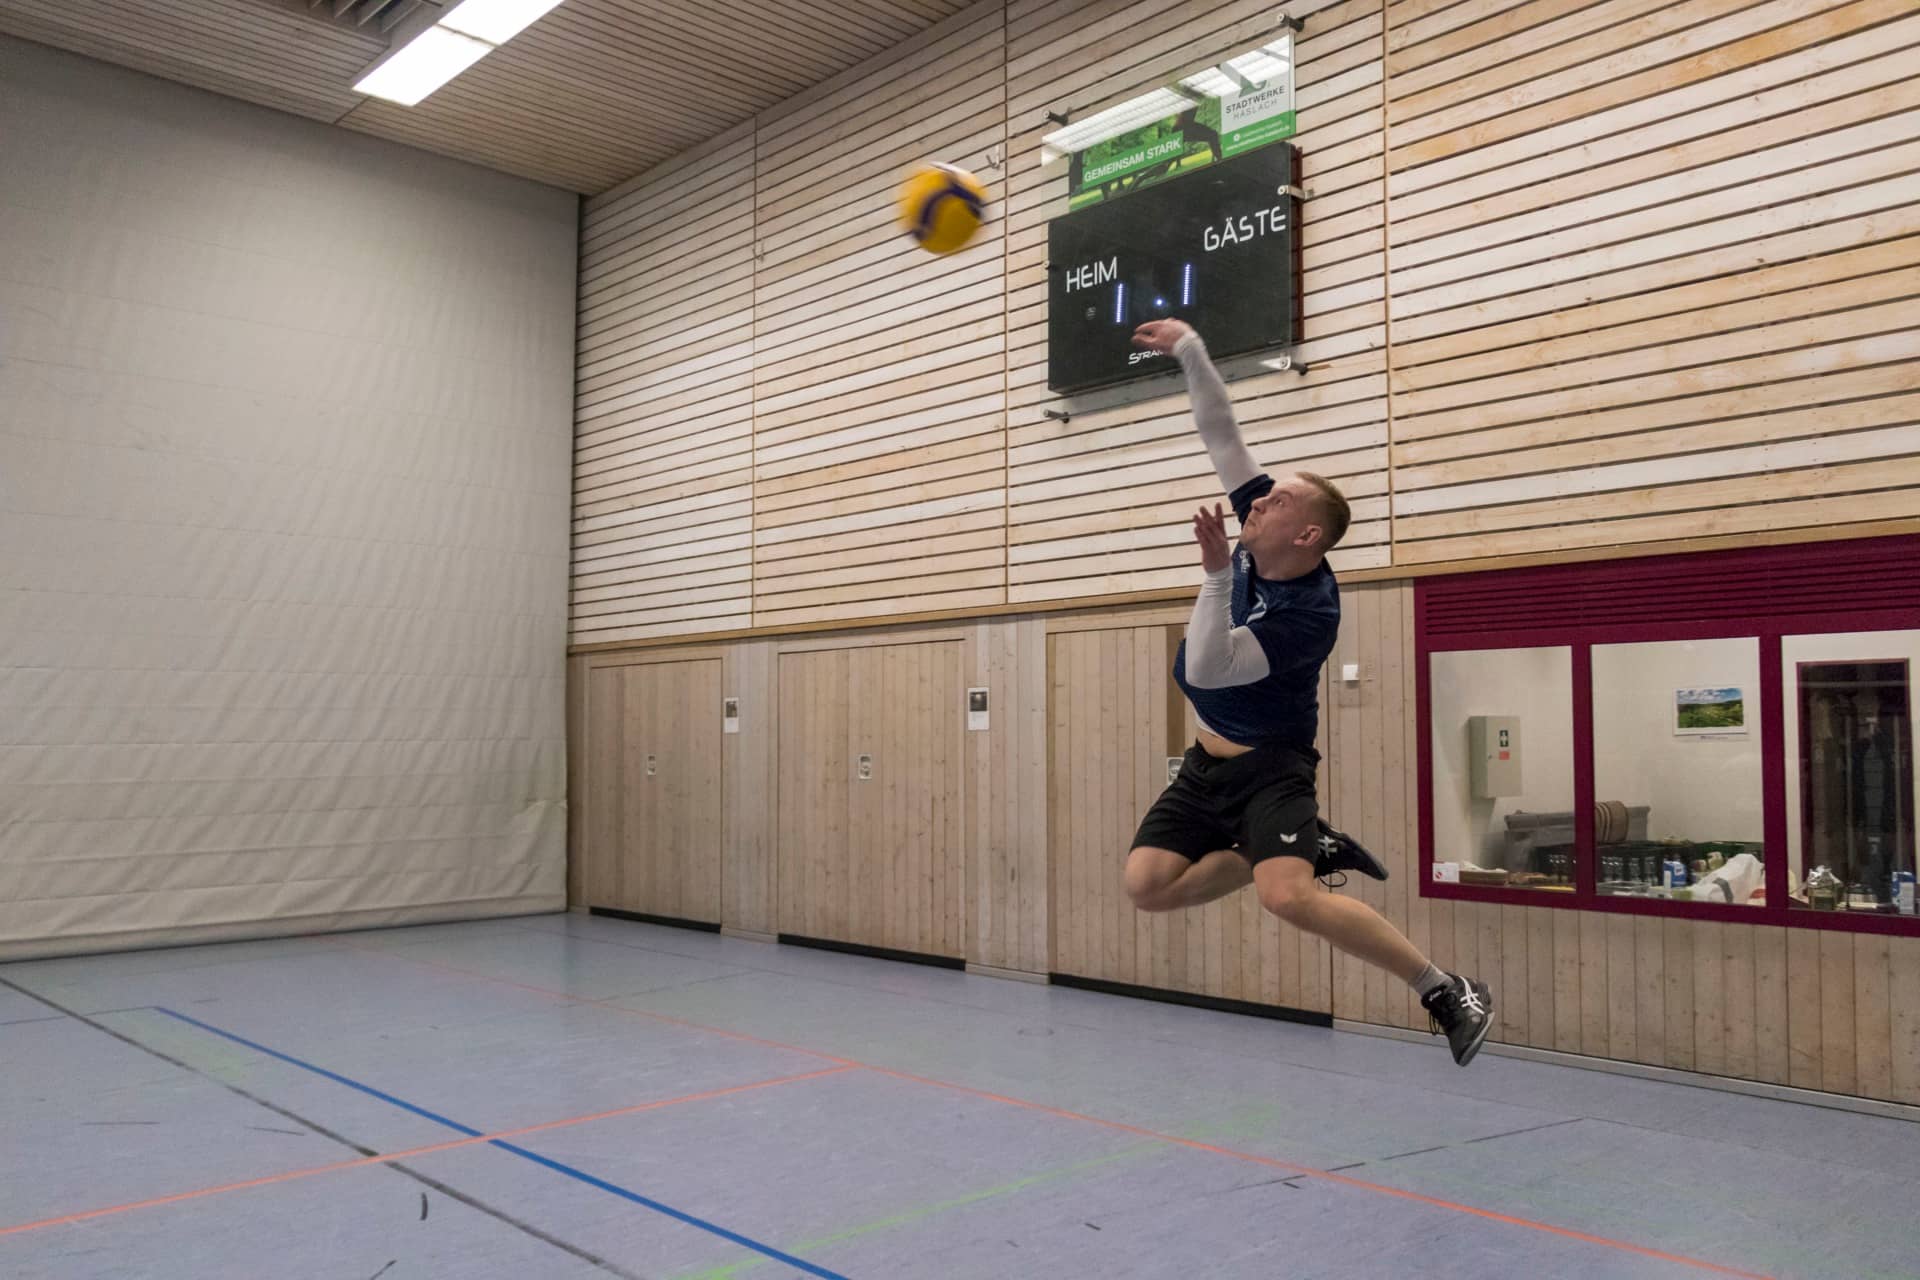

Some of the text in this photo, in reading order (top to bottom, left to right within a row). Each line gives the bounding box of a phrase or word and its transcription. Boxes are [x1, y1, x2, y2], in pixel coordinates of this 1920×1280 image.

[1226, 85, 1285, 114] STADTWERKE
[1084, 139, 1181, 183] GEMEINSAM STARK
[1204, 206, 1286, 251] GÄSTE
[1066, 256, 1118, 293] HEIM
